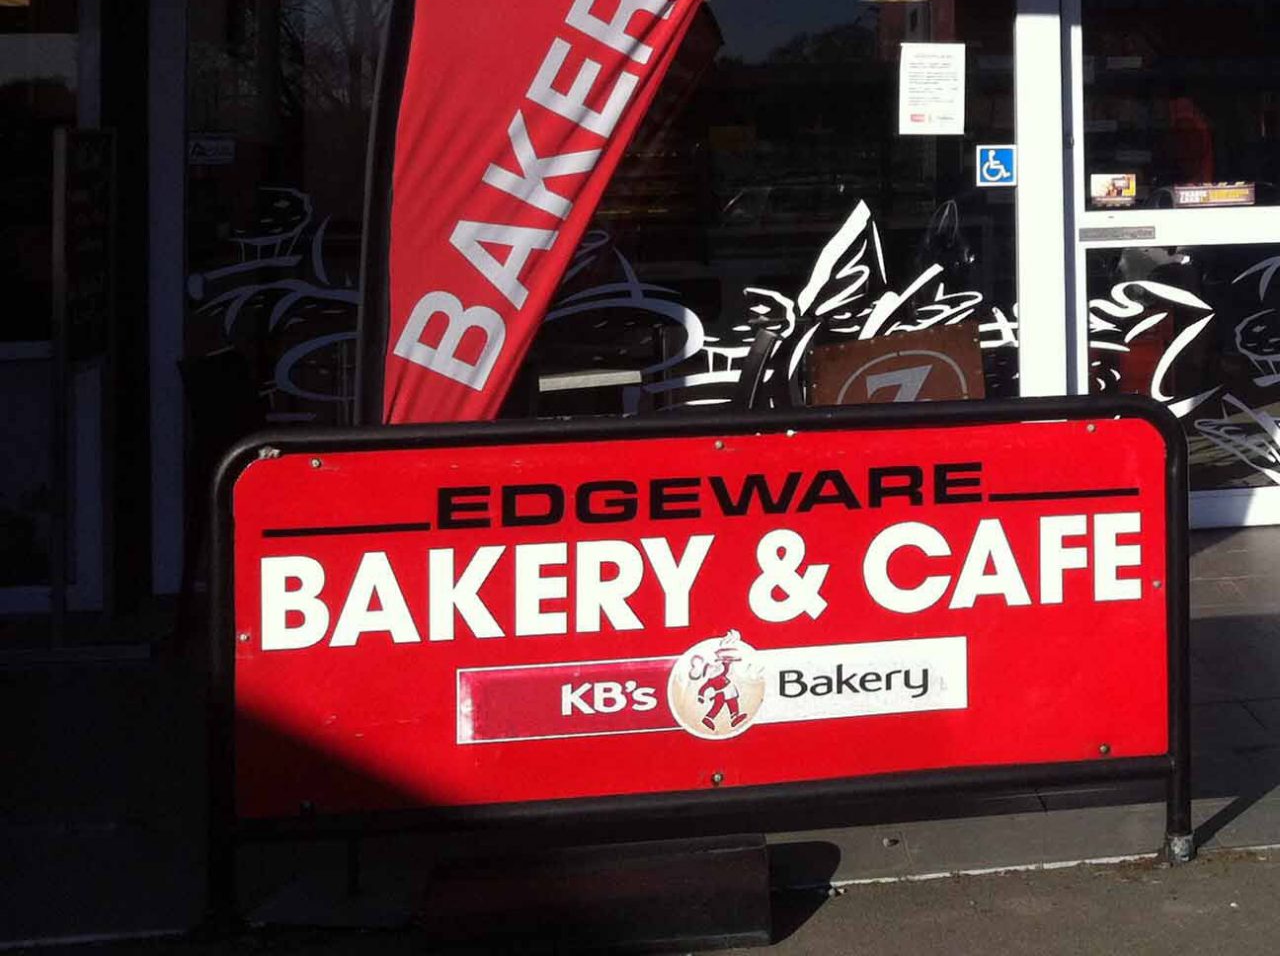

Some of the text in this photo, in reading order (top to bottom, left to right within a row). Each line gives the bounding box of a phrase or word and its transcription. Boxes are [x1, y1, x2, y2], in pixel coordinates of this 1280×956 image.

[435, 461, 984, 532] EDGEWARE
[259, 512, 1143, 651] BAKERY & CAFE
[560, 662, 931, 717] KB's Bakery
